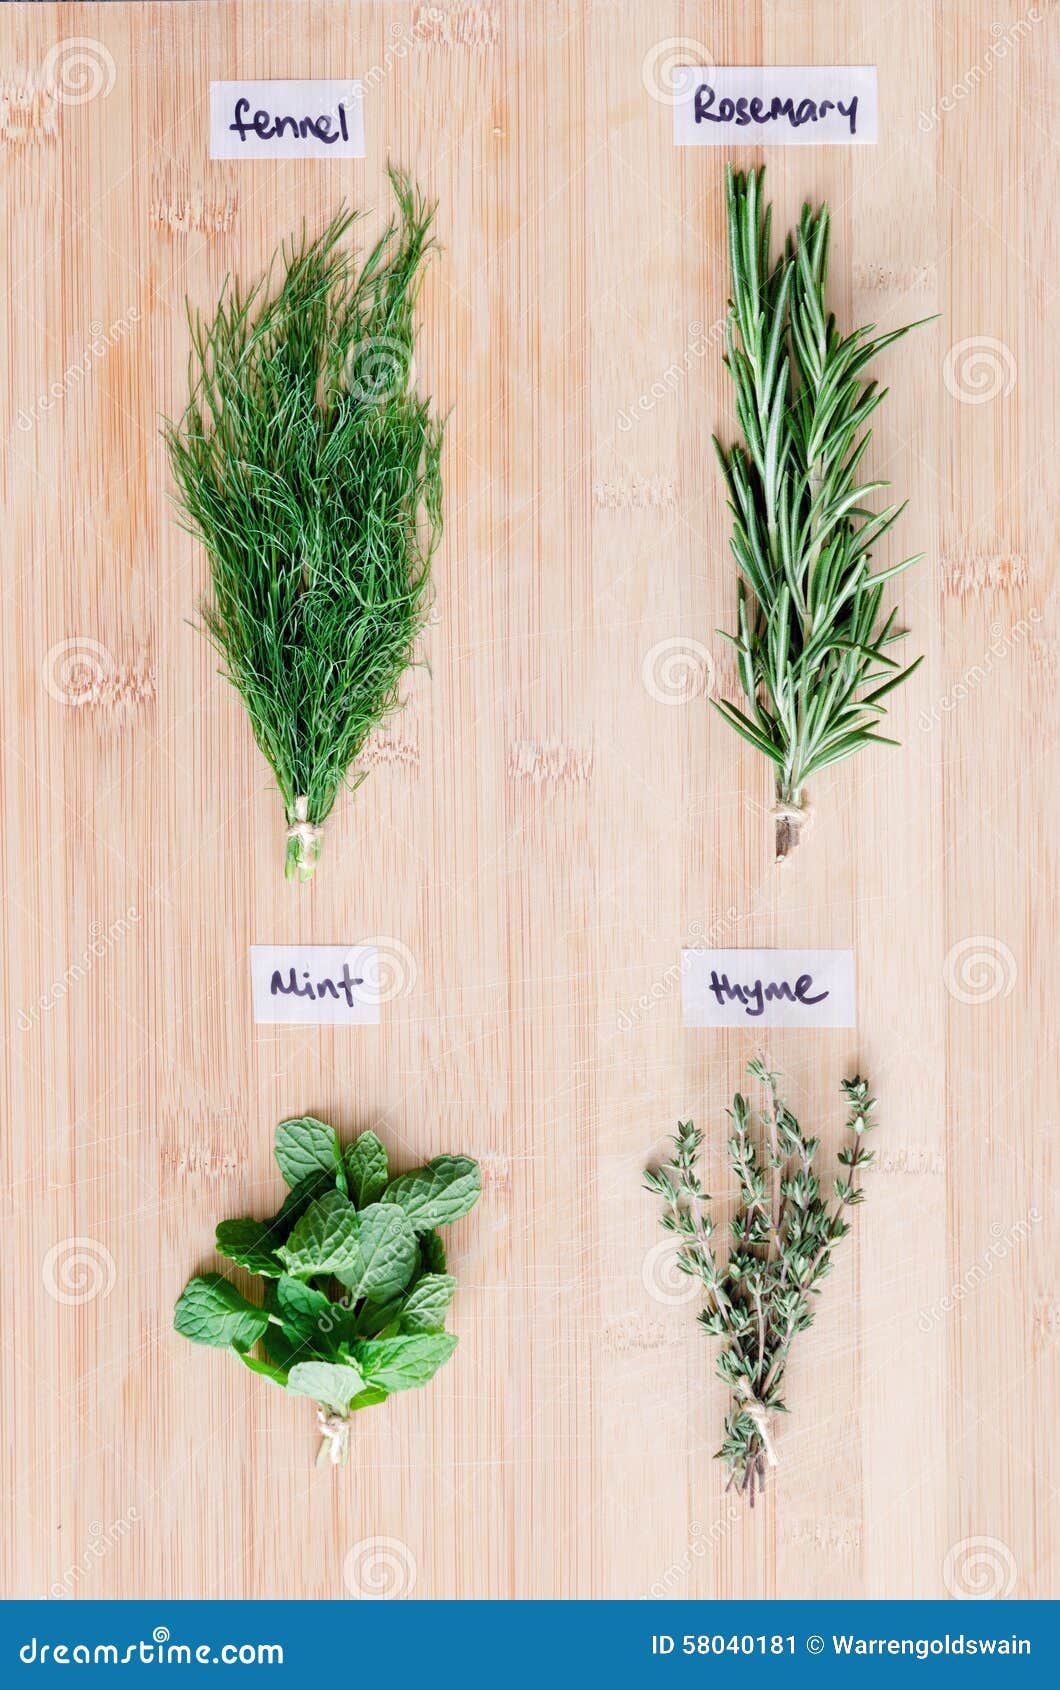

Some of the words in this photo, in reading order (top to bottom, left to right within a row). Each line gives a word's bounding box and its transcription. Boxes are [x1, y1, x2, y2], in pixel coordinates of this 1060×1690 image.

[229, 97, 349, 145] fennel
[694, 84, 859, 135] Rosemary
[708, 970, 830, 1016] thyme
